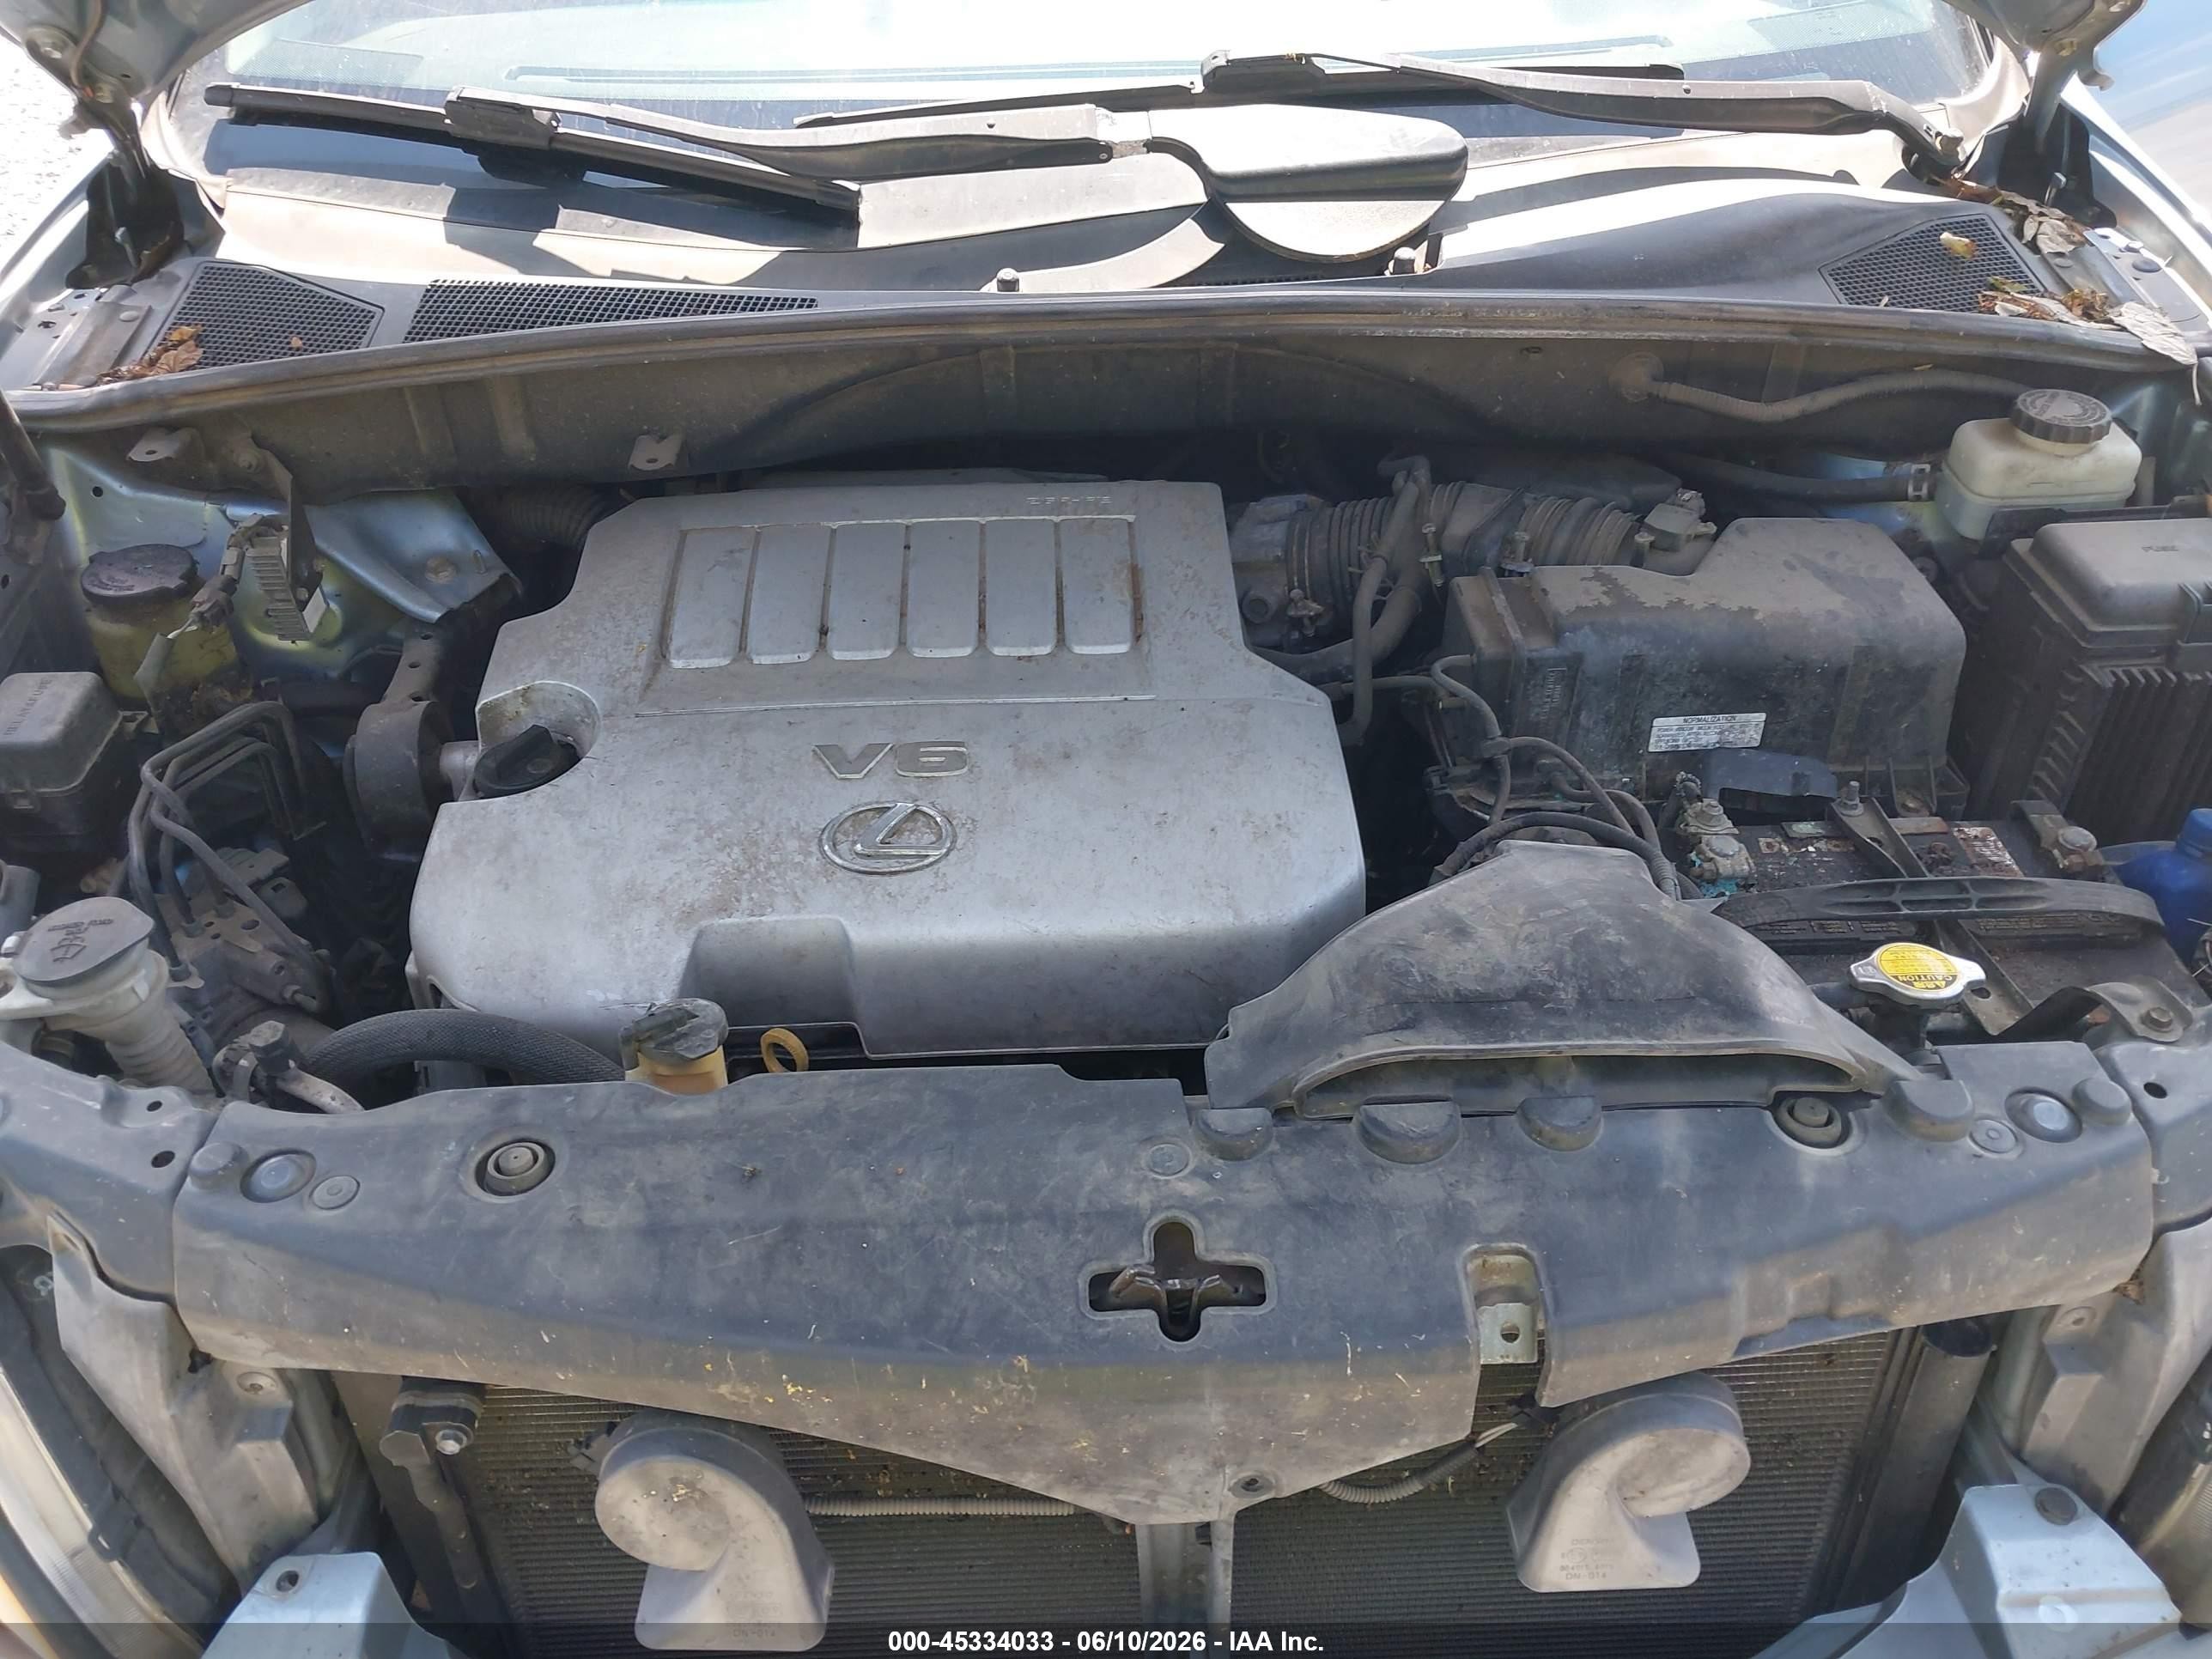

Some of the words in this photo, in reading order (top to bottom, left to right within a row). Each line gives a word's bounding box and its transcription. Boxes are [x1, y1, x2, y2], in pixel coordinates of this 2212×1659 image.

[1682, 715, 1737, 724] NORMALIZATION
[811, 740, 969, 780] V6
[1898, 974, 1953, 982] CAUTION
